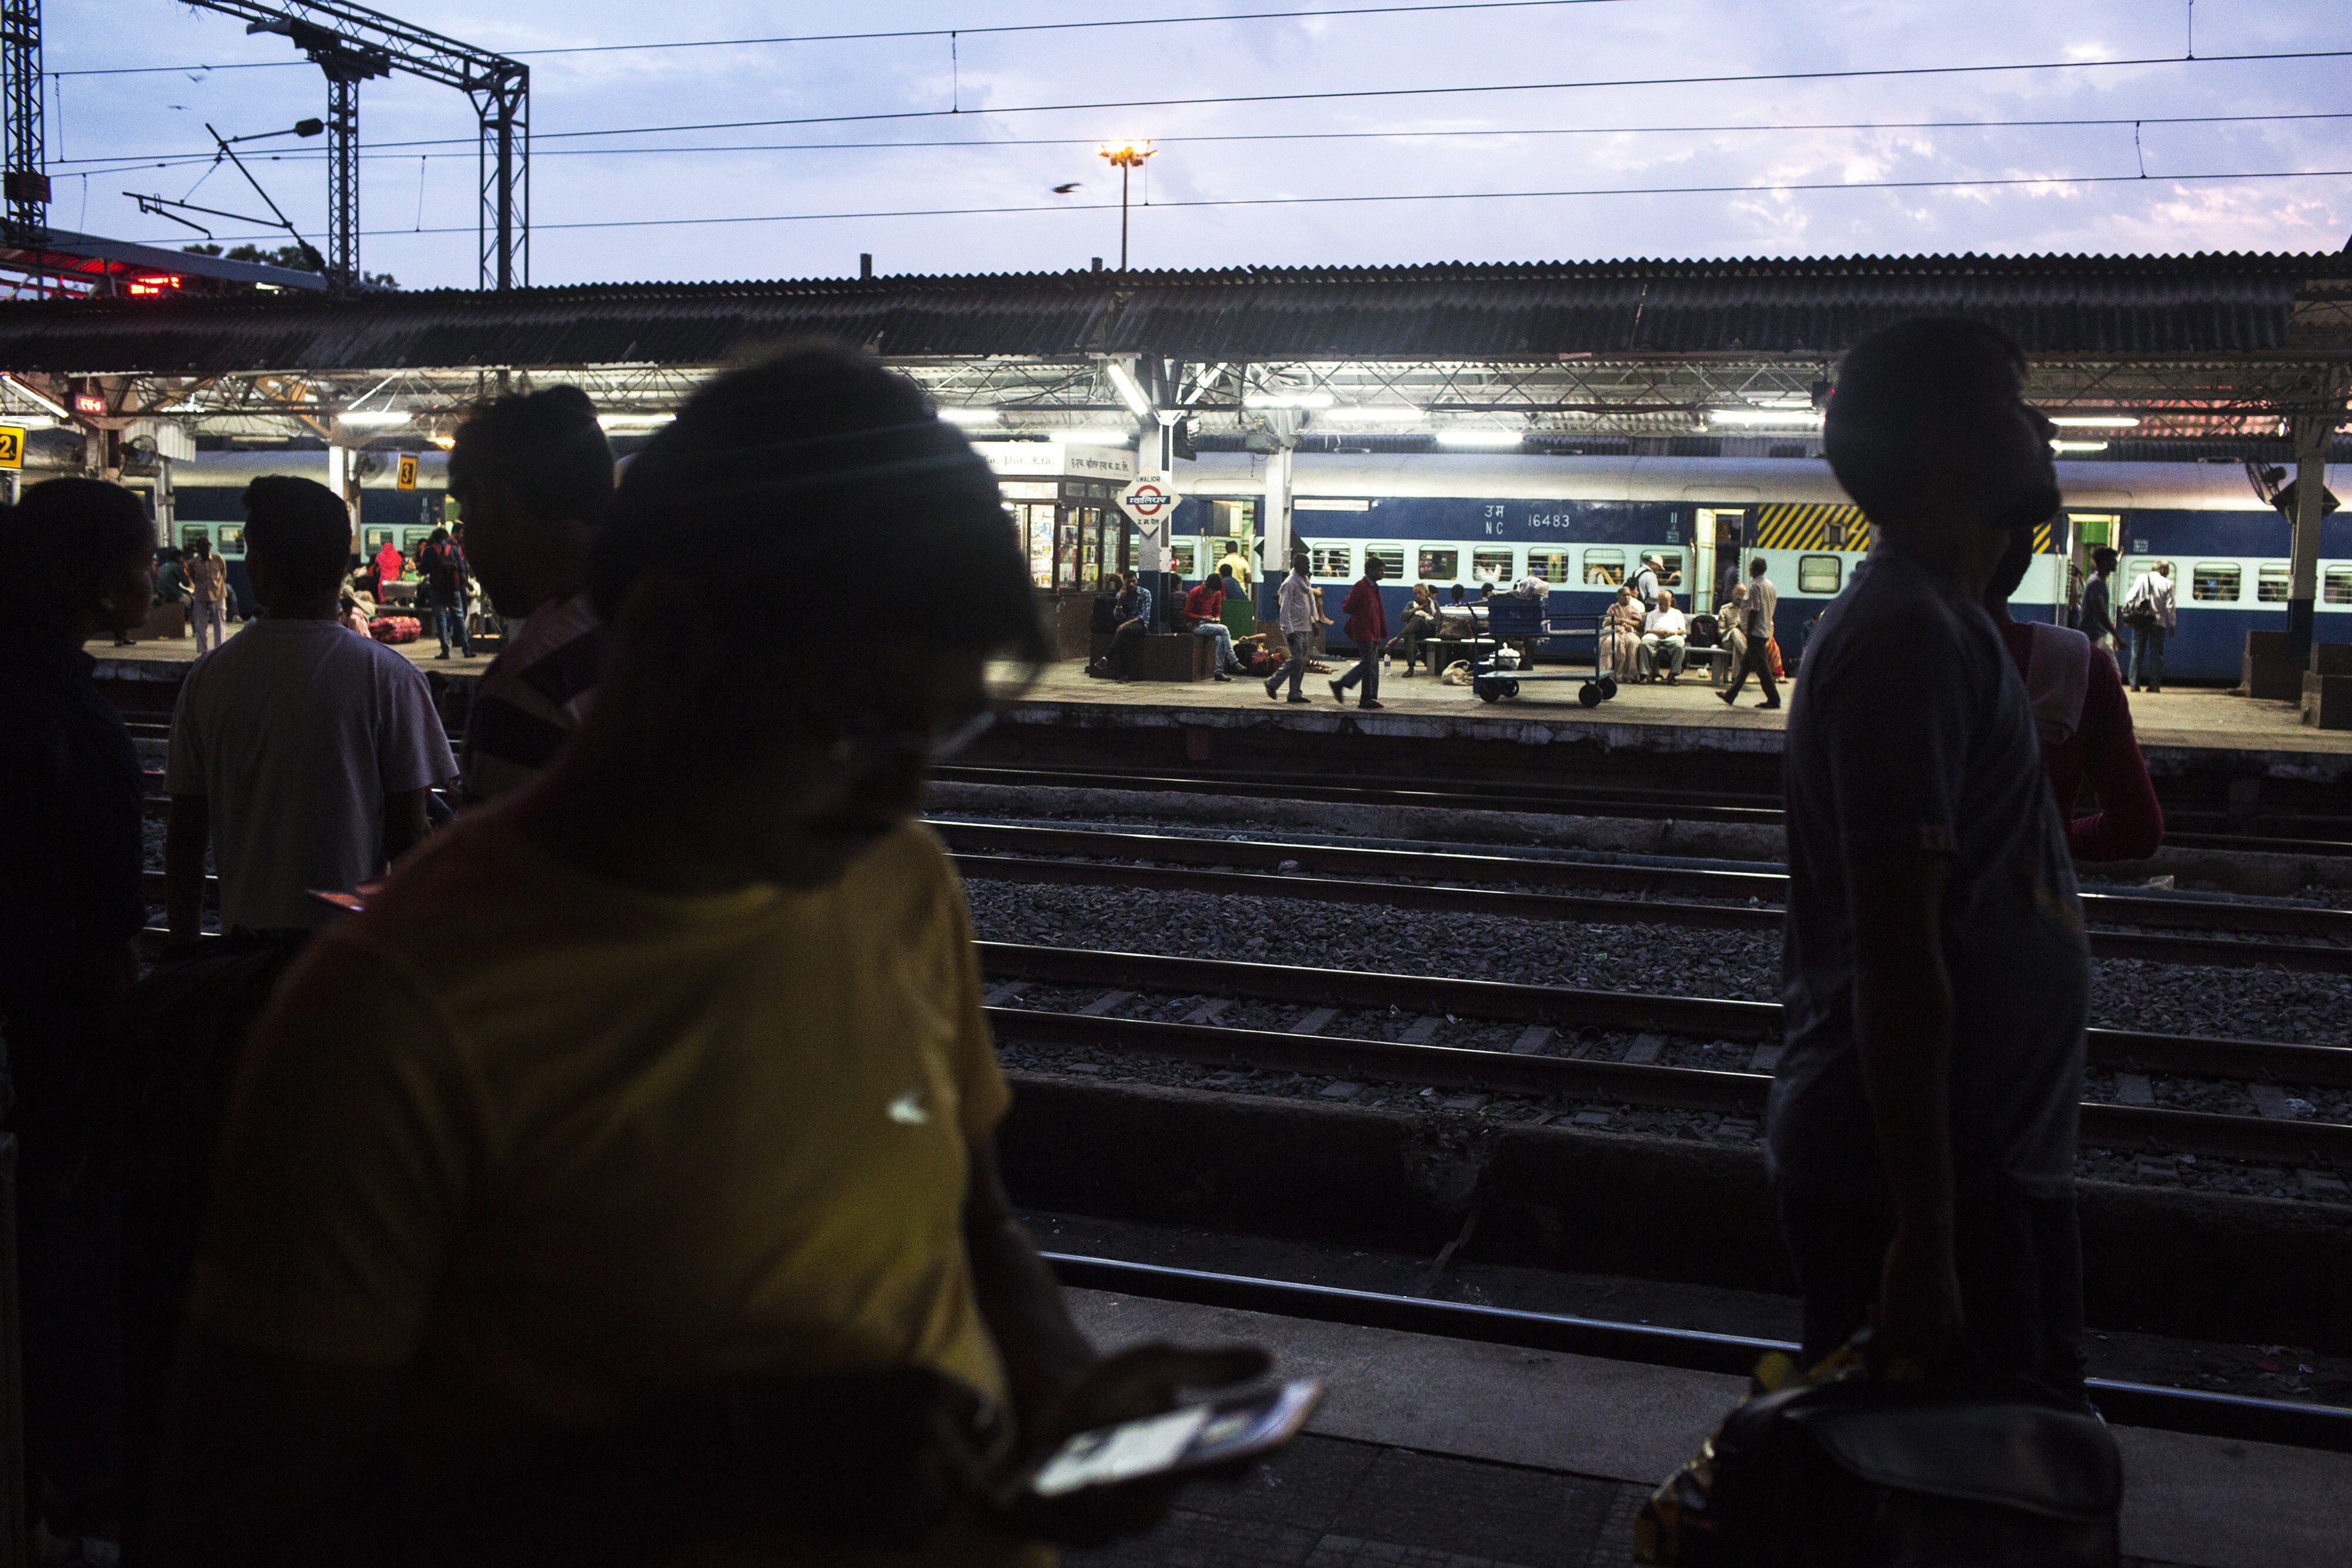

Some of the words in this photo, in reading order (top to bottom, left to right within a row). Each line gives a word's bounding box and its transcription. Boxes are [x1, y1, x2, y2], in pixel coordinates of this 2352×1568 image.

[1031, 455, 1055, 465] Ltd.
[1129, 495, 1167, 504] ग्वालियर
[1528, 514, 1569, 527] 16483
